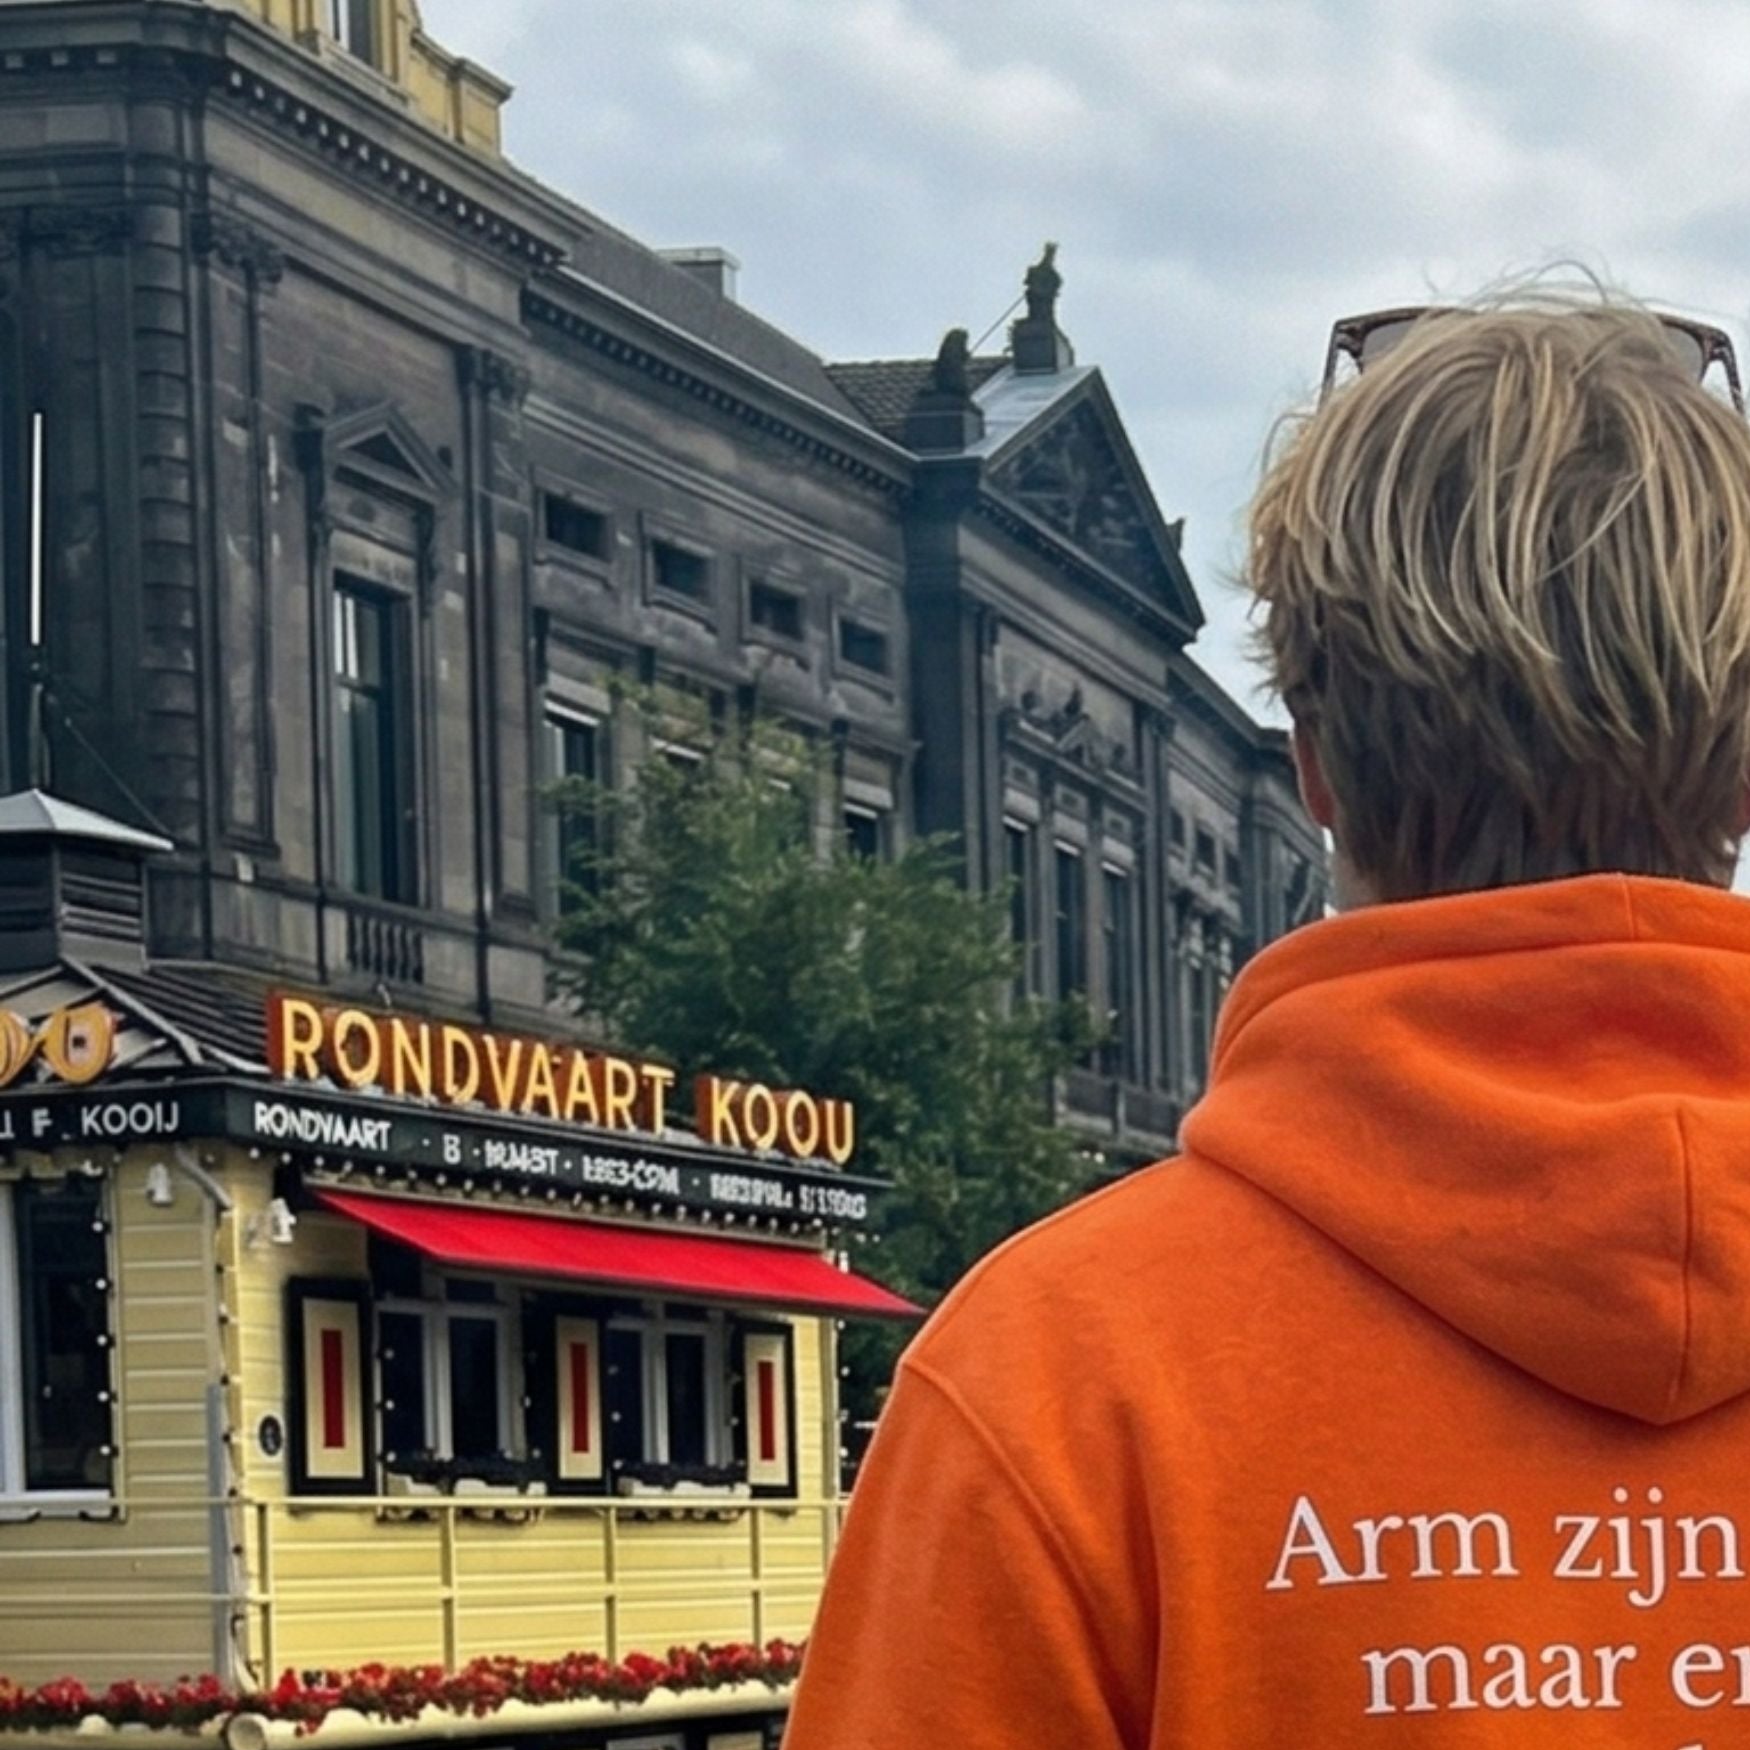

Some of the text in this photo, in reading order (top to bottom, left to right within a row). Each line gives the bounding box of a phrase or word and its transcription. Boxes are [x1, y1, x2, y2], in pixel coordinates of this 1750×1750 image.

[280, 998, 675, 1136] RONDVAART
[81, 1102, 180, 1136] KOOIJ
[254, 1102, 391, 1151] RONDVAART
[1266, 1496, 1518, 1589] Arm
[1553, 1488, 1744, 1607] zijn
[1361, 1640, 1636, 1715] maar
